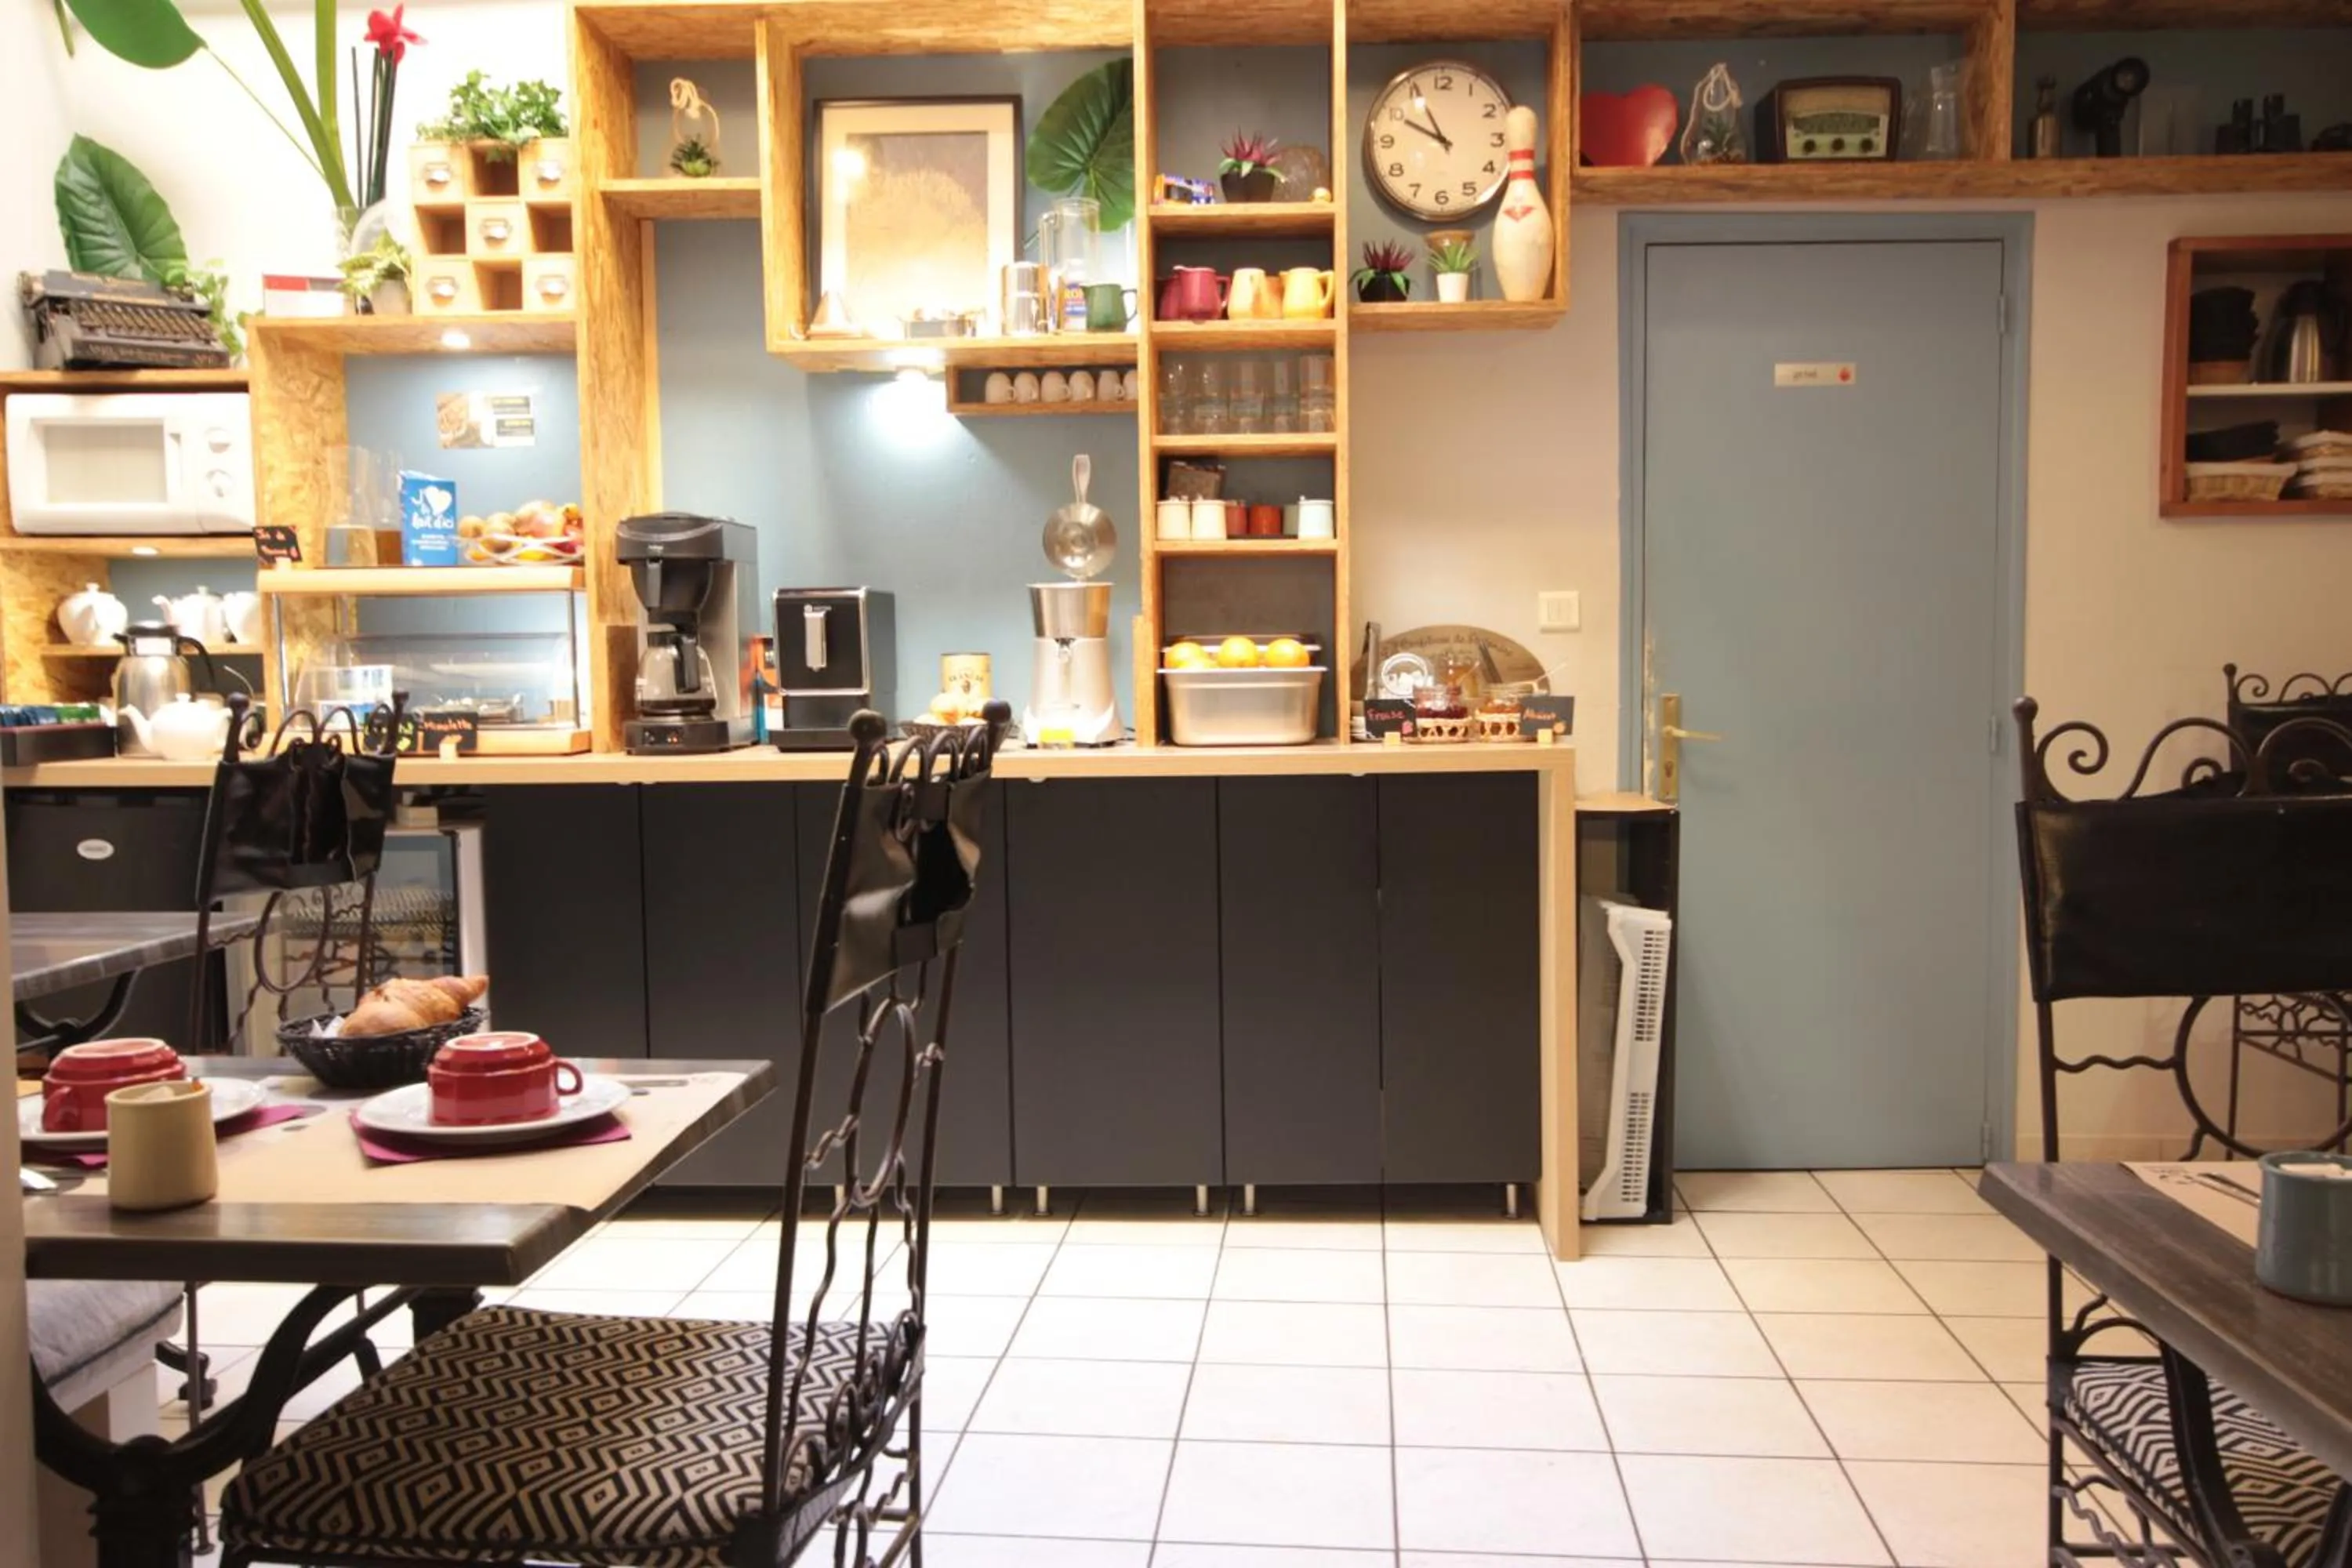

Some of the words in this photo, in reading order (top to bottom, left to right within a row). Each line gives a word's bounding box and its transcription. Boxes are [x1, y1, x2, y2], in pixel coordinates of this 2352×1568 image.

[1434, 76, 1453, 91] 12
[1468, 82, 1473, 97] 1
[1389, 107, 1404, 121] 10
[1482, 103, 1497, 118] 2
[1380, 134, 1395, 149] 9
[1490, 132, 1504, 147] 3
[1388, 162, 1404, 177] 8
[1482, 160, 1496, 173] 4
[1408, 183, 1421, 198] 7
[1461, 181, 1477, 196] 5
[1434, 191, 1449, 205] 6
